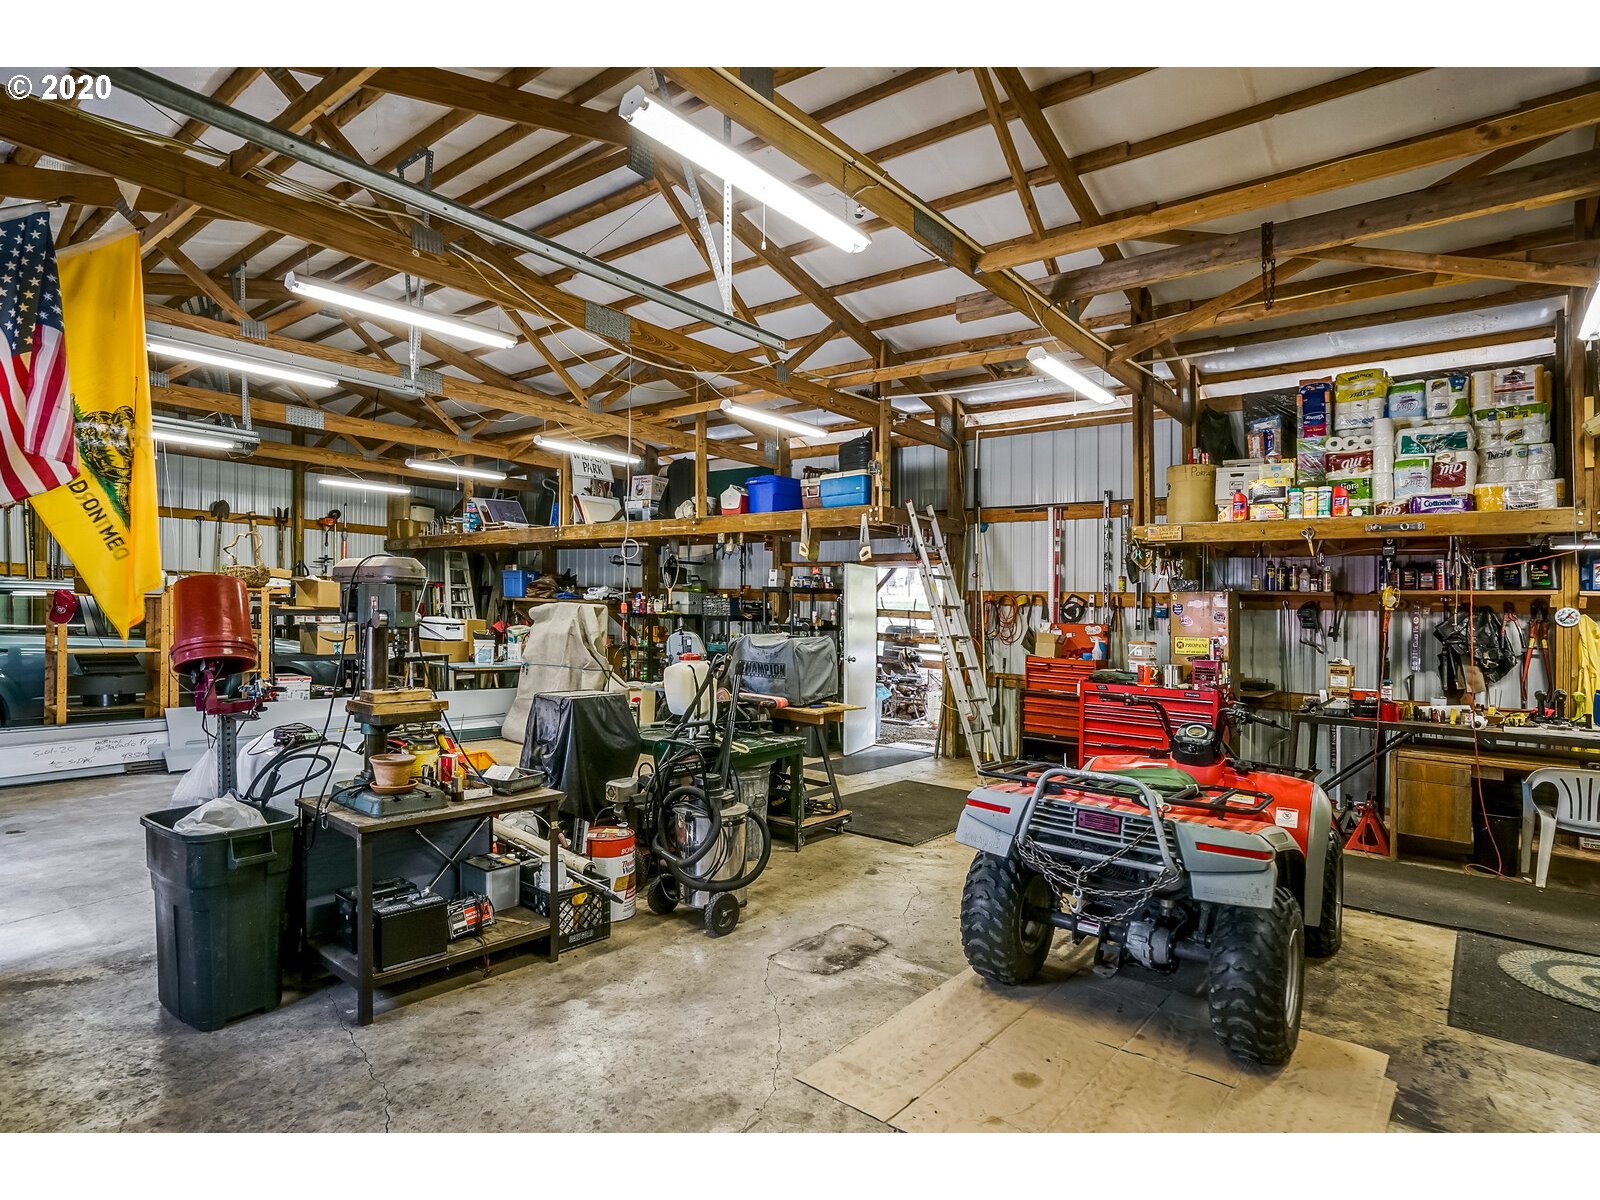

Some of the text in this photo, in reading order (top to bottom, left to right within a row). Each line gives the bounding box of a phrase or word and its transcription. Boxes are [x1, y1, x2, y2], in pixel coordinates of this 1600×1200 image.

[1487, 448, 1512, 460] Thirsty
[582, 461, 604, 475] PARK
[1423, 499, 1460, 507] Cottonelle
[743, 661, 786, 677] HAMPION
